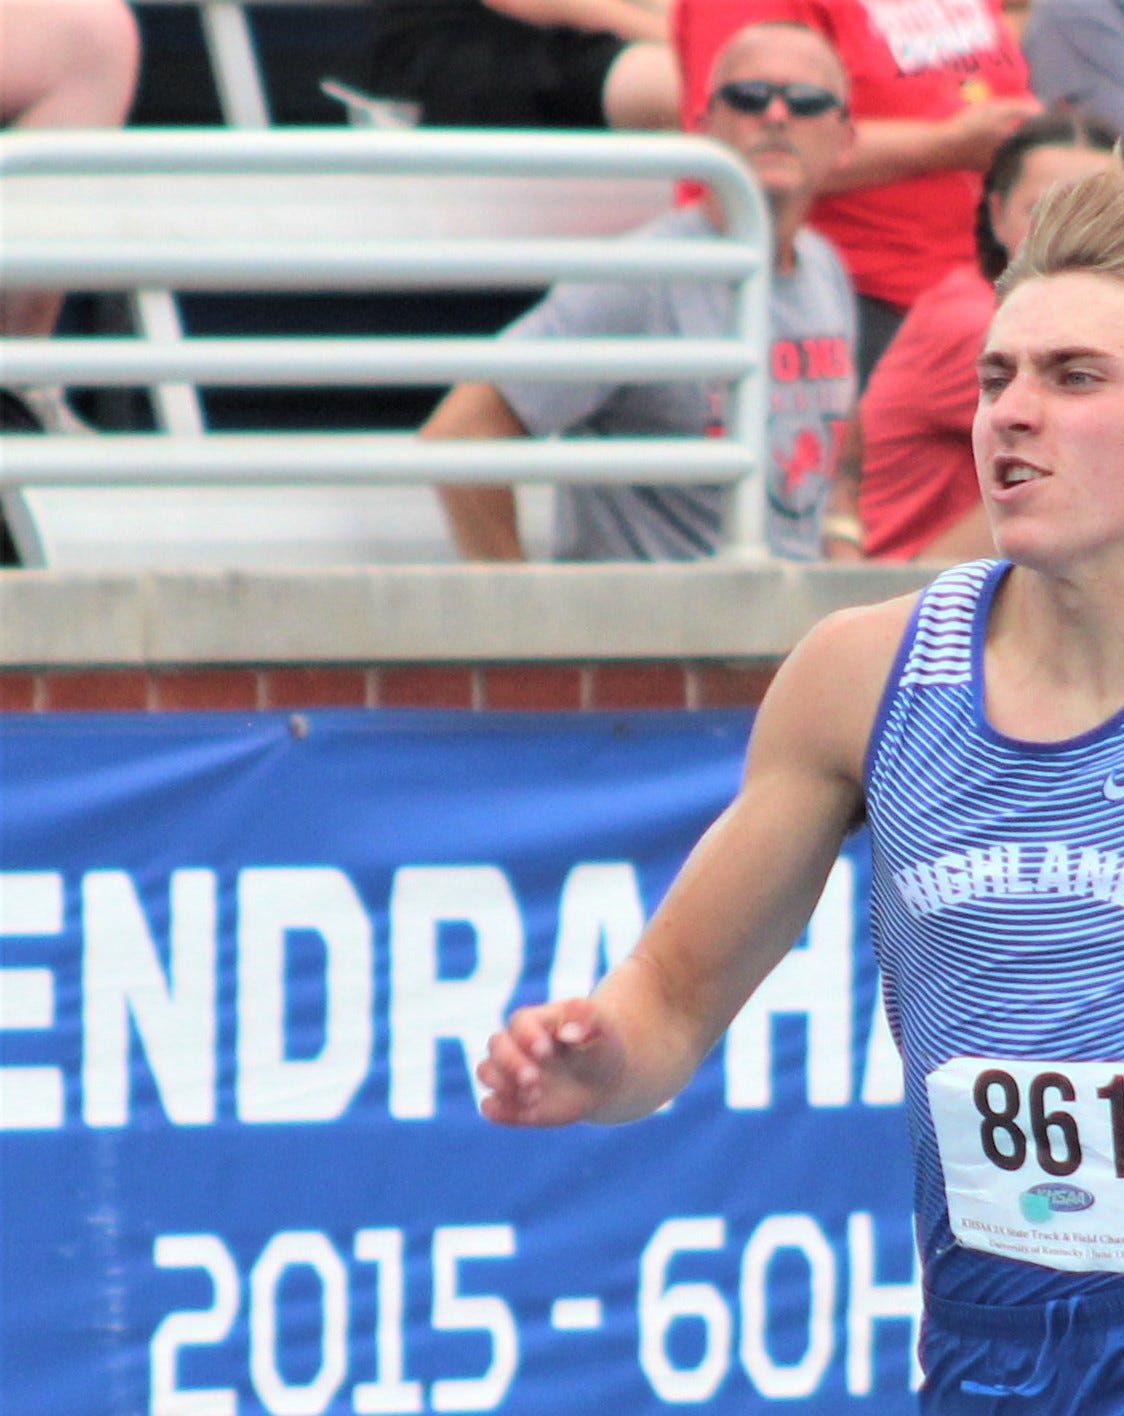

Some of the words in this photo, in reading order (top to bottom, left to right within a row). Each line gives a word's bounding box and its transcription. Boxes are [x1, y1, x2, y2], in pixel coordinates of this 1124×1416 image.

[1031, 1229, 1059, 1241] Track
[1063, 1232, 1070, 1241] &
[1071, 1232, 1097, 1243] Field
[1043, 1245, 1083, 1258] Kentucky
